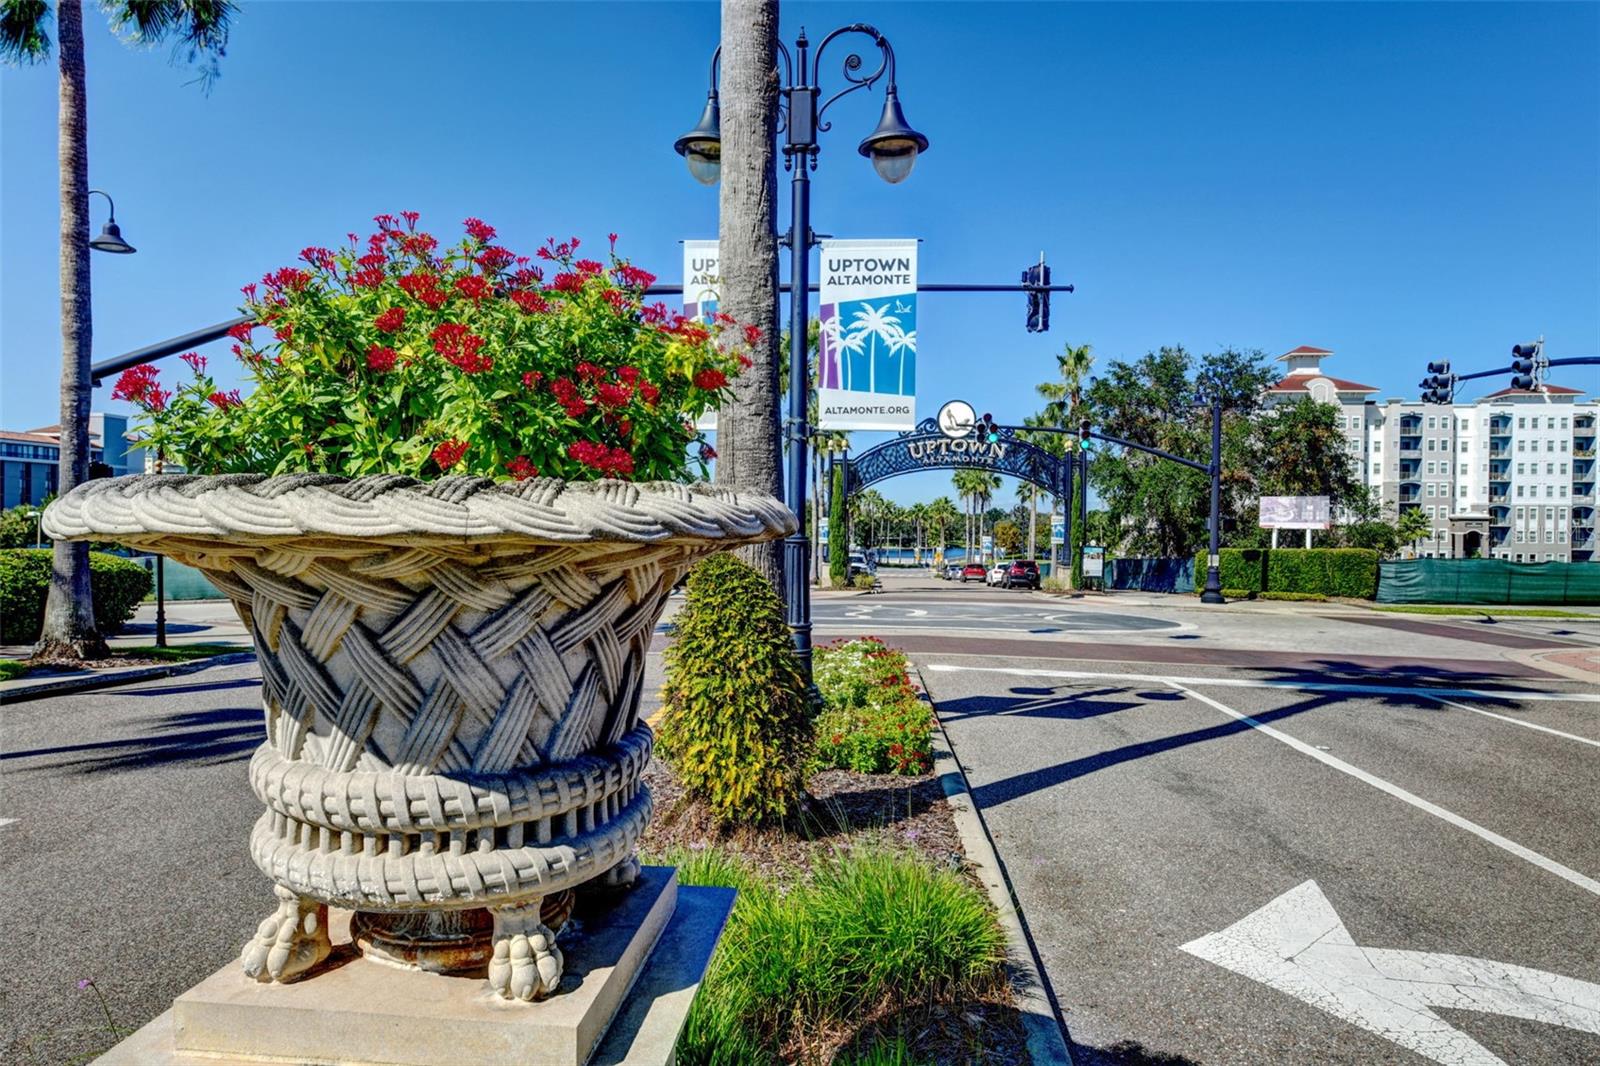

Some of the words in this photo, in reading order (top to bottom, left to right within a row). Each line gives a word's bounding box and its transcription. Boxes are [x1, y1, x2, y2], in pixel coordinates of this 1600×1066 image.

[828, 258, 910, 272] UPTOWN
[827, 274, 911, 286] ALTAMONTE
[825, 406, 910, 415] ALTAMONTE.ORG
[908, 439, 1008, 459] UPTOWN
[922, 455, 994, 464] ALTAMONTE
